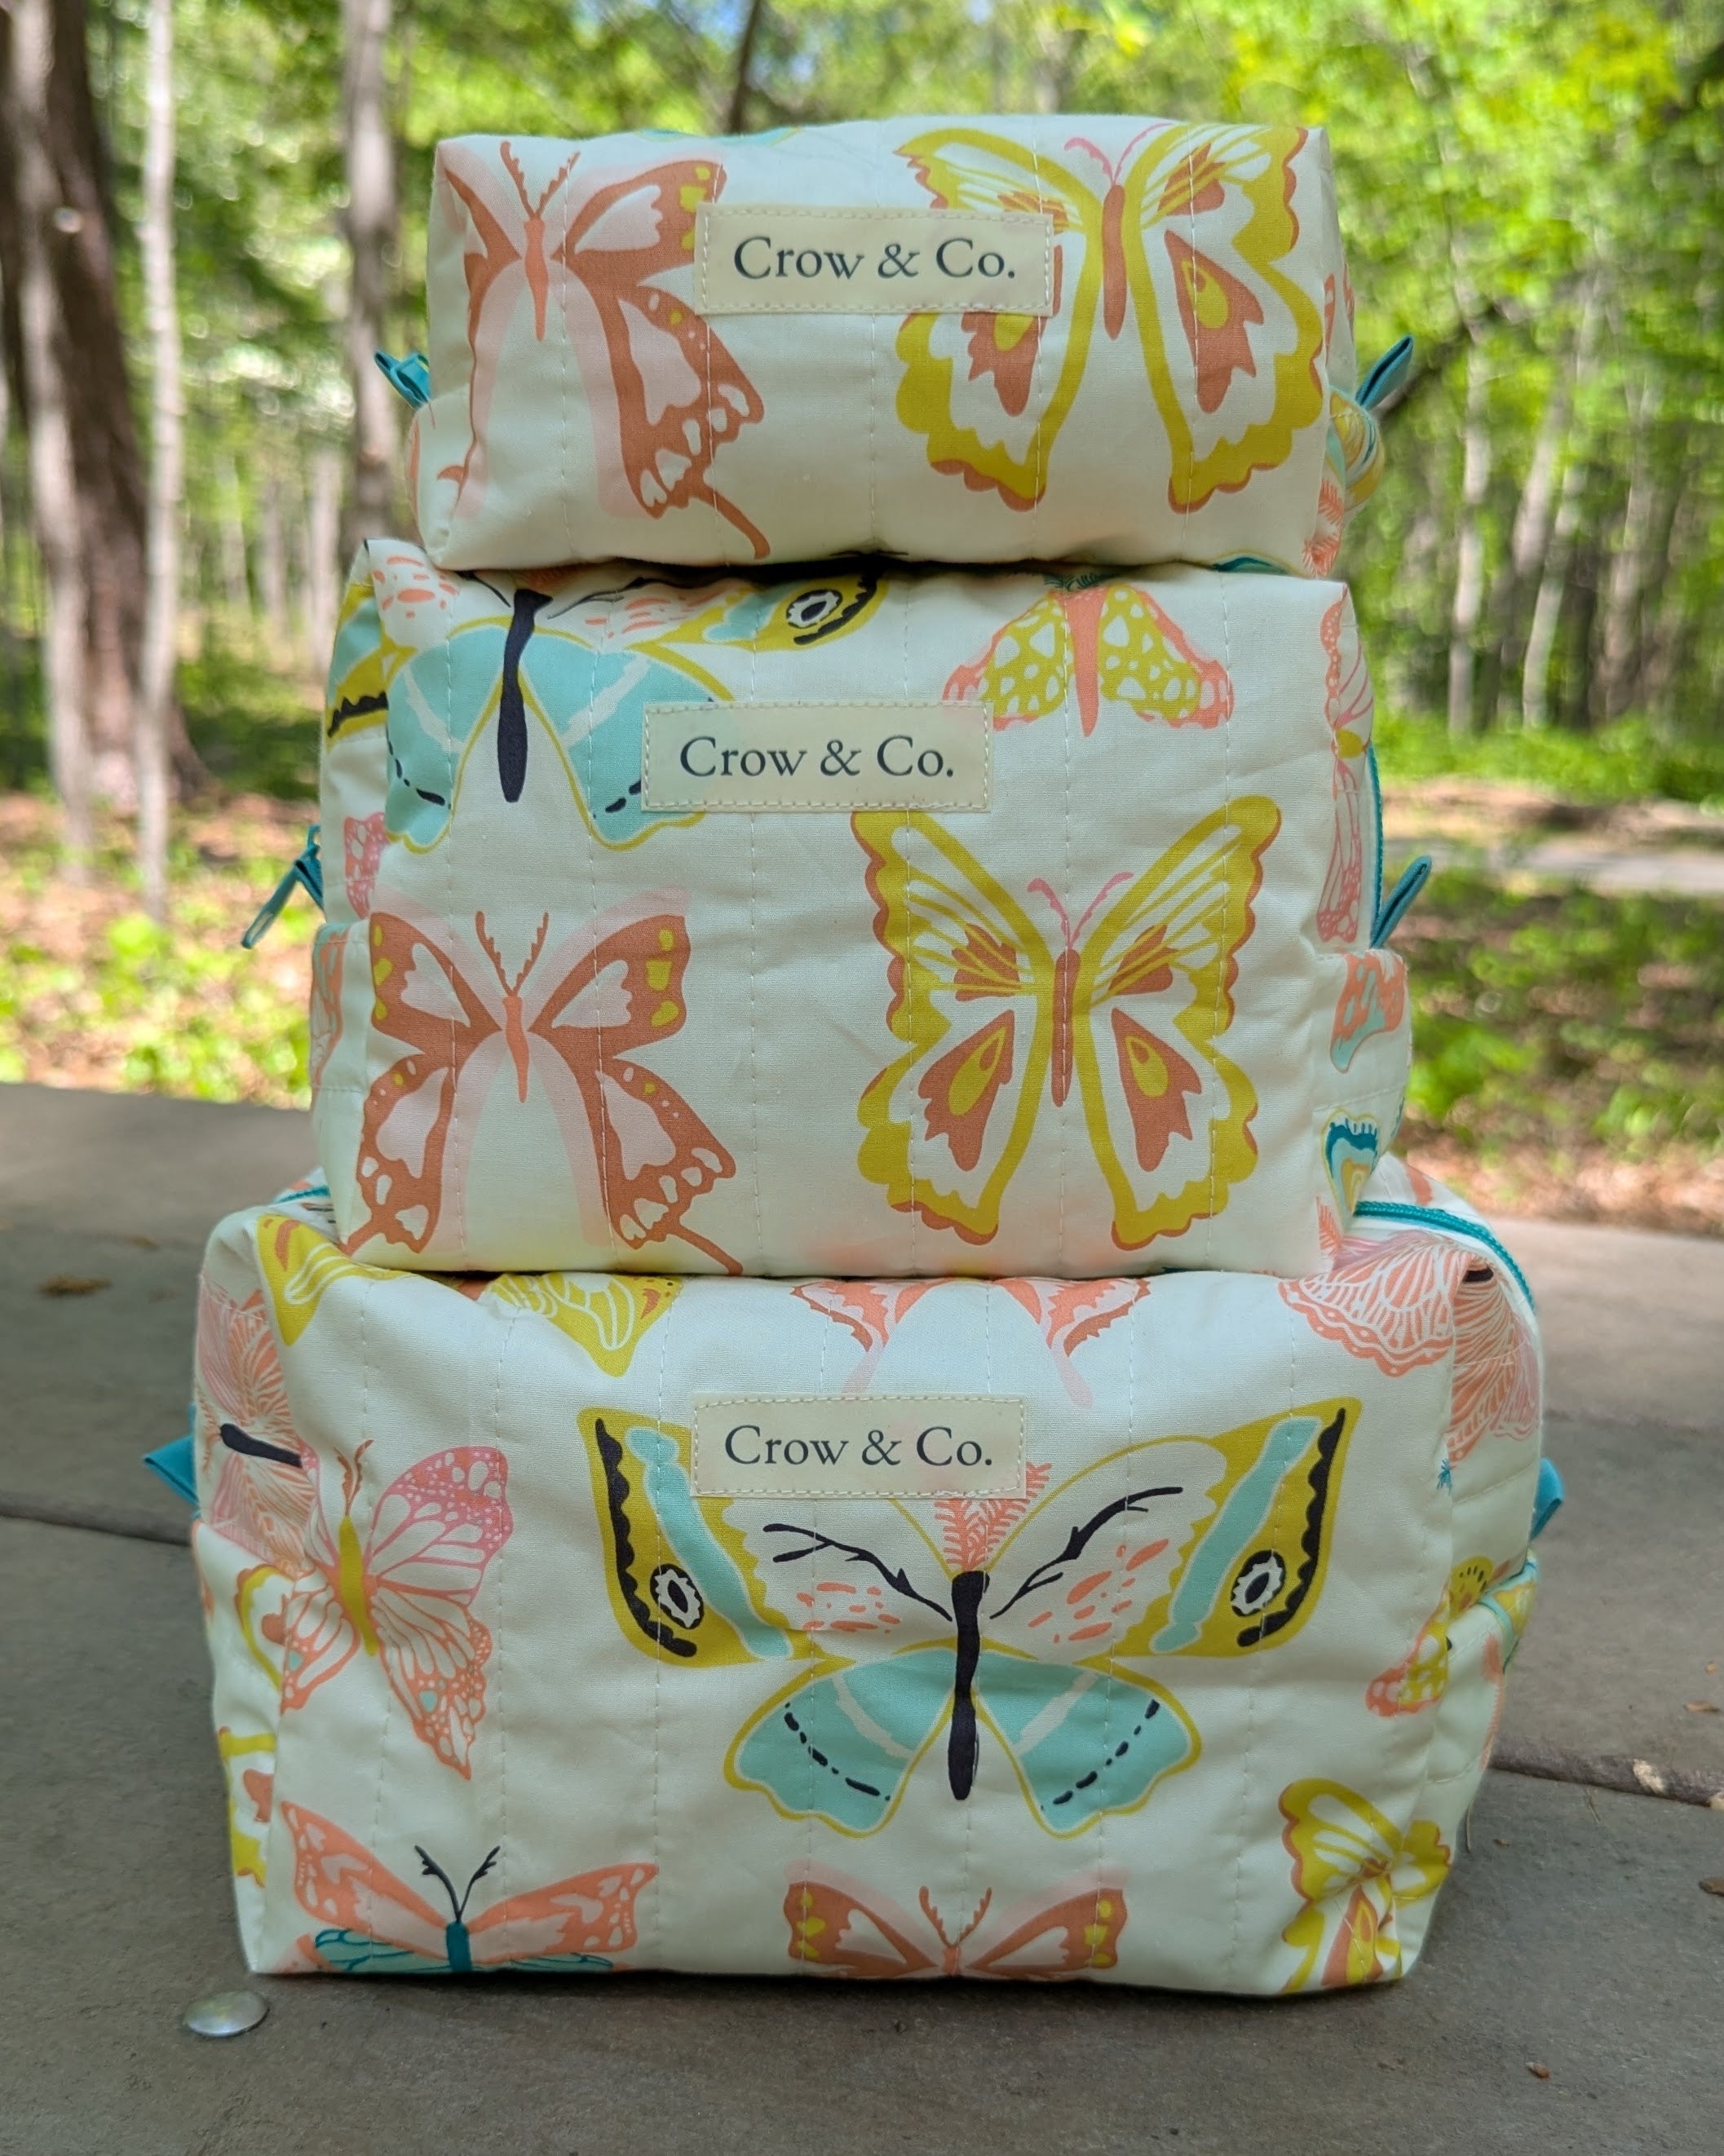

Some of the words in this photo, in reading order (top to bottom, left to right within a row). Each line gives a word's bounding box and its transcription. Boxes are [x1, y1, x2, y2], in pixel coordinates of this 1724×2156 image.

[733, 236, 864, 280] Crow
[877, 243, 921, 279] &
[935, 237, 1015, 279] Co.
[679, 736, 807, 777] Crow
[820, 739, 862, 777] &
[877, 735, 954, 778] Co.
[724, 1425, 850, 1465] Crow
[861, 1429, 903, 1466] &
[916, 1425, 992, 1467] Co.
